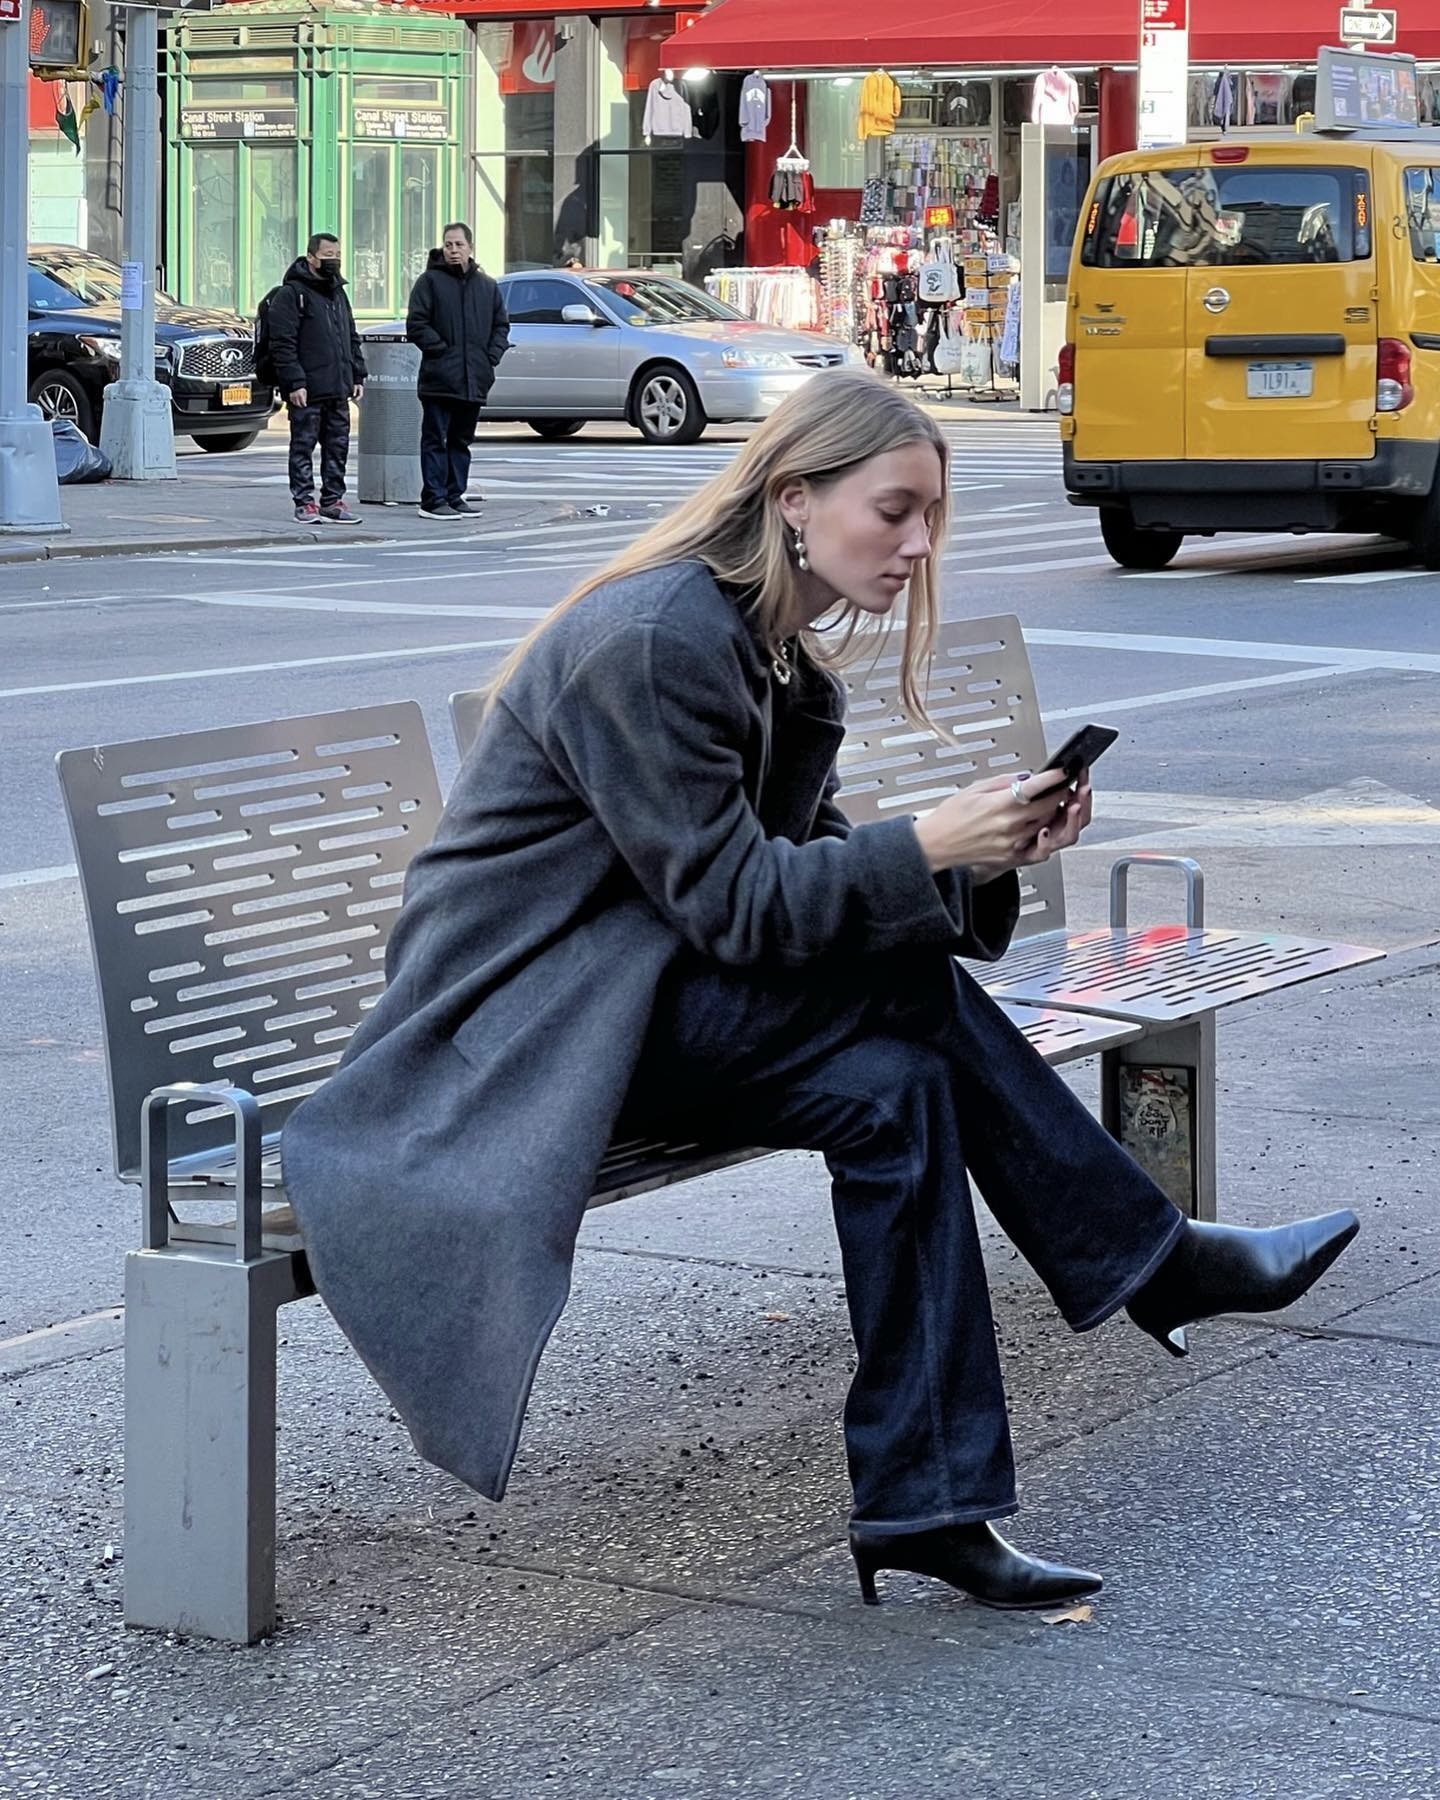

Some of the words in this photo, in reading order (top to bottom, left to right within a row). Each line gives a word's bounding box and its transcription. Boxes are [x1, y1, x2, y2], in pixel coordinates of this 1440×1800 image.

[1369, 19, 1387, 32] WAY
[181, 111, 205, 122] Canal
[207, 111, 232, 122] Street
[235, 111, 265, 122] Station
[355, 109, 380, 121] Canal
[382, 110, 408, 122] Street
[411, 112, 442, 124] Station
[368, 374, 379, 382] Put
[380, 374, 398, 382] litter
[401, 374, 409, 382] in
[1149, 1127, 1168, 1138] RIP
